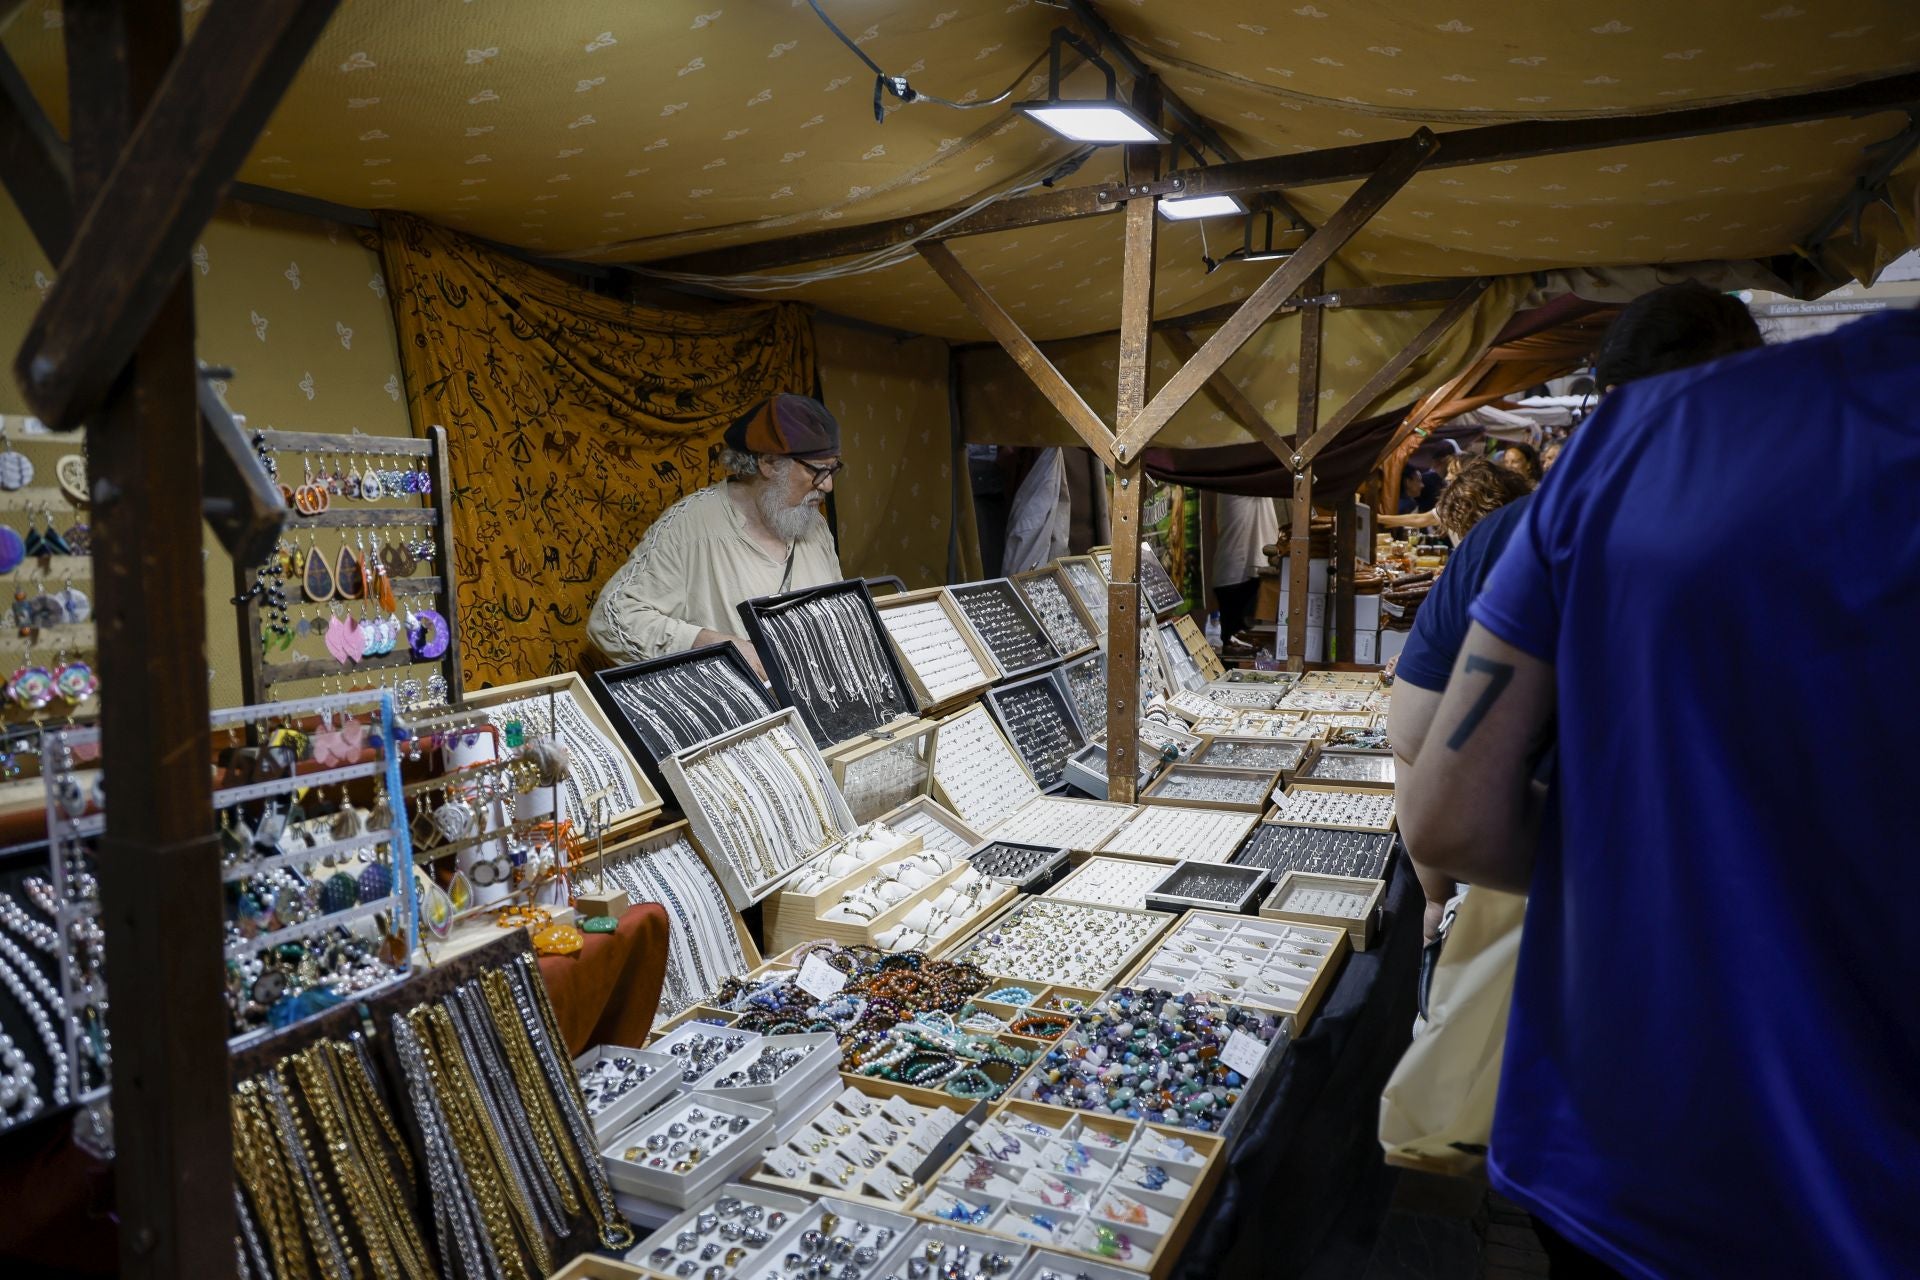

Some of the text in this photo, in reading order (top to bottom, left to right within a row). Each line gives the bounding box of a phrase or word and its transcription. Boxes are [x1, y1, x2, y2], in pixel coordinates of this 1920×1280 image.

[1770, 300, 1886, 314] Edificio Servicios Universitarios
[1447, 655, 1515, 751] 7
